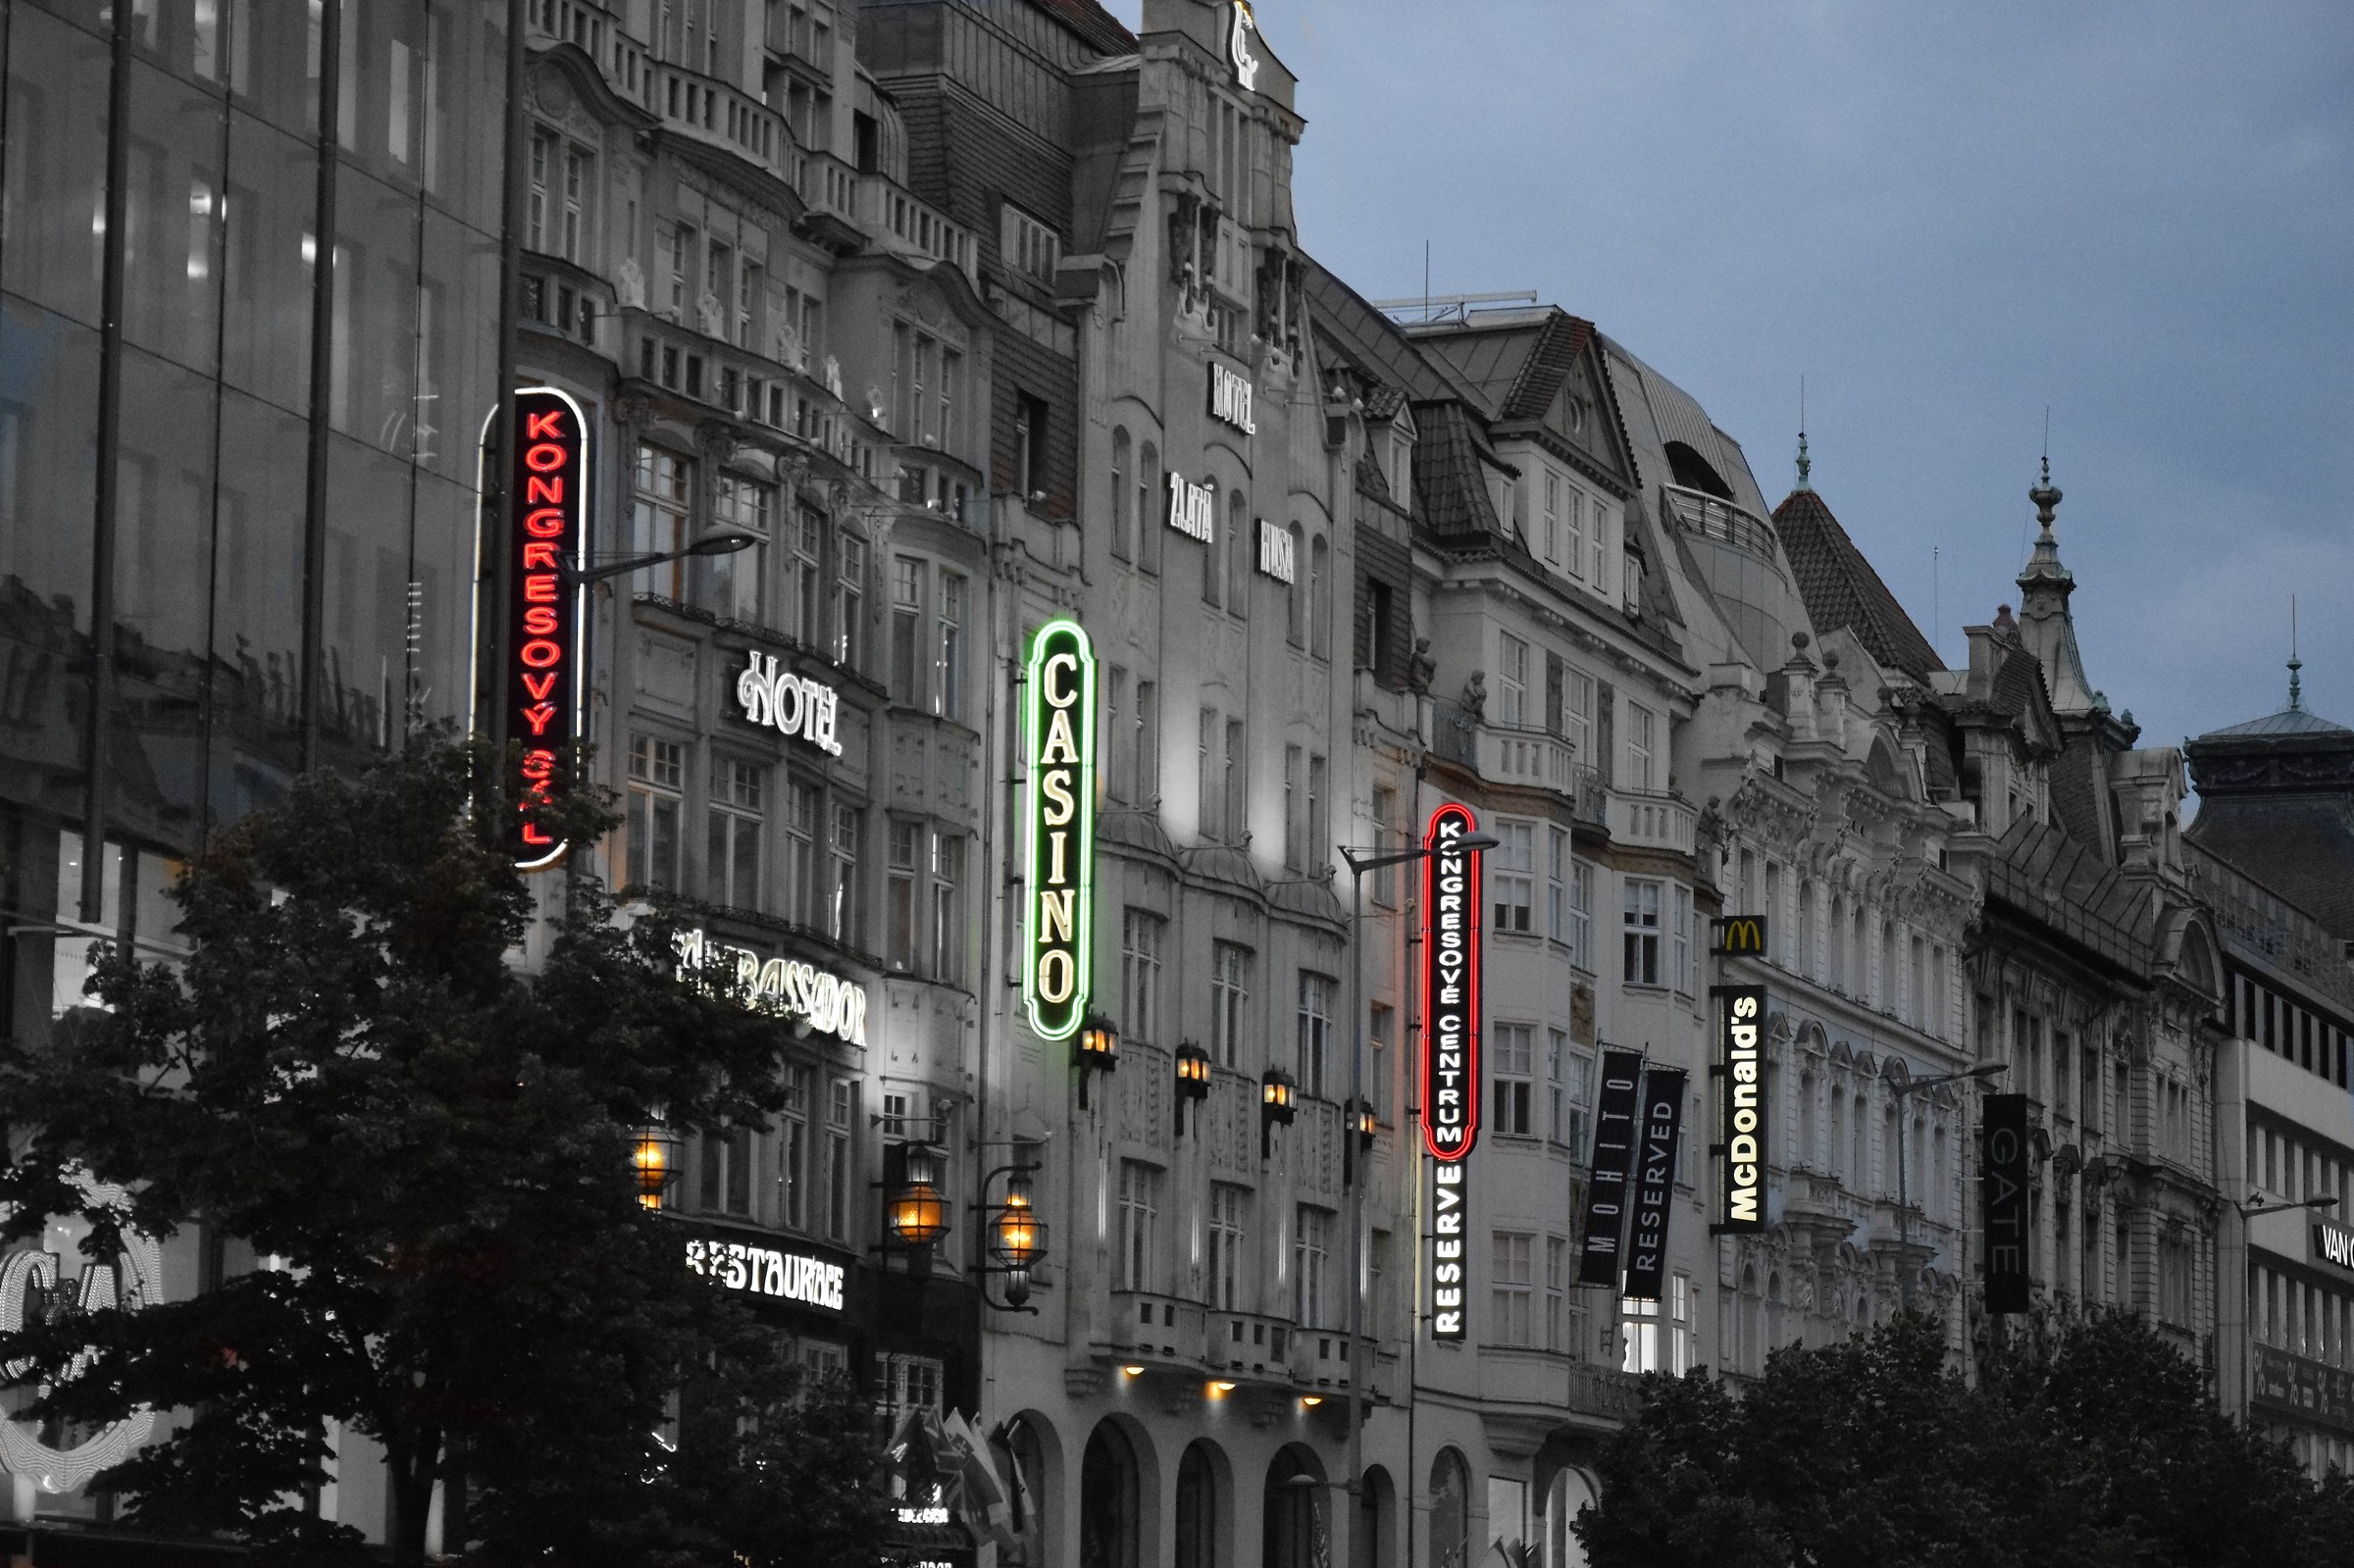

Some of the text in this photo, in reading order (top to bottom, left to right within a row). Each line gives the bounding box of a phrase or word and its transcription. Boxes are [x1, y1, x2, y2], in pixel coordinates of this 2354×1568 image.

[1213, 362, 1256, 435] HOTEL
[520, 410, 568, 735] KONGRESOVÝ
[1260, 519, 1295, 584] HUSA
[737, 649, 843, 757] HOTEL
[1038, 652, 1079, 1004] CASINO
[1436, 1014, 1461, 1143] CENTRUM
[1730, 995, 1758, 1222] McDonald's
[1587, 1078, 1634, 1253] MOHITO
[1635, 1101, 1672, 1272] RESERVED
[1991, 1127, 2020, 1274] GATE
[2322, 1224, 2348, 1266] VAN
[1435, 1159, 1461, 1334] RESERVE
